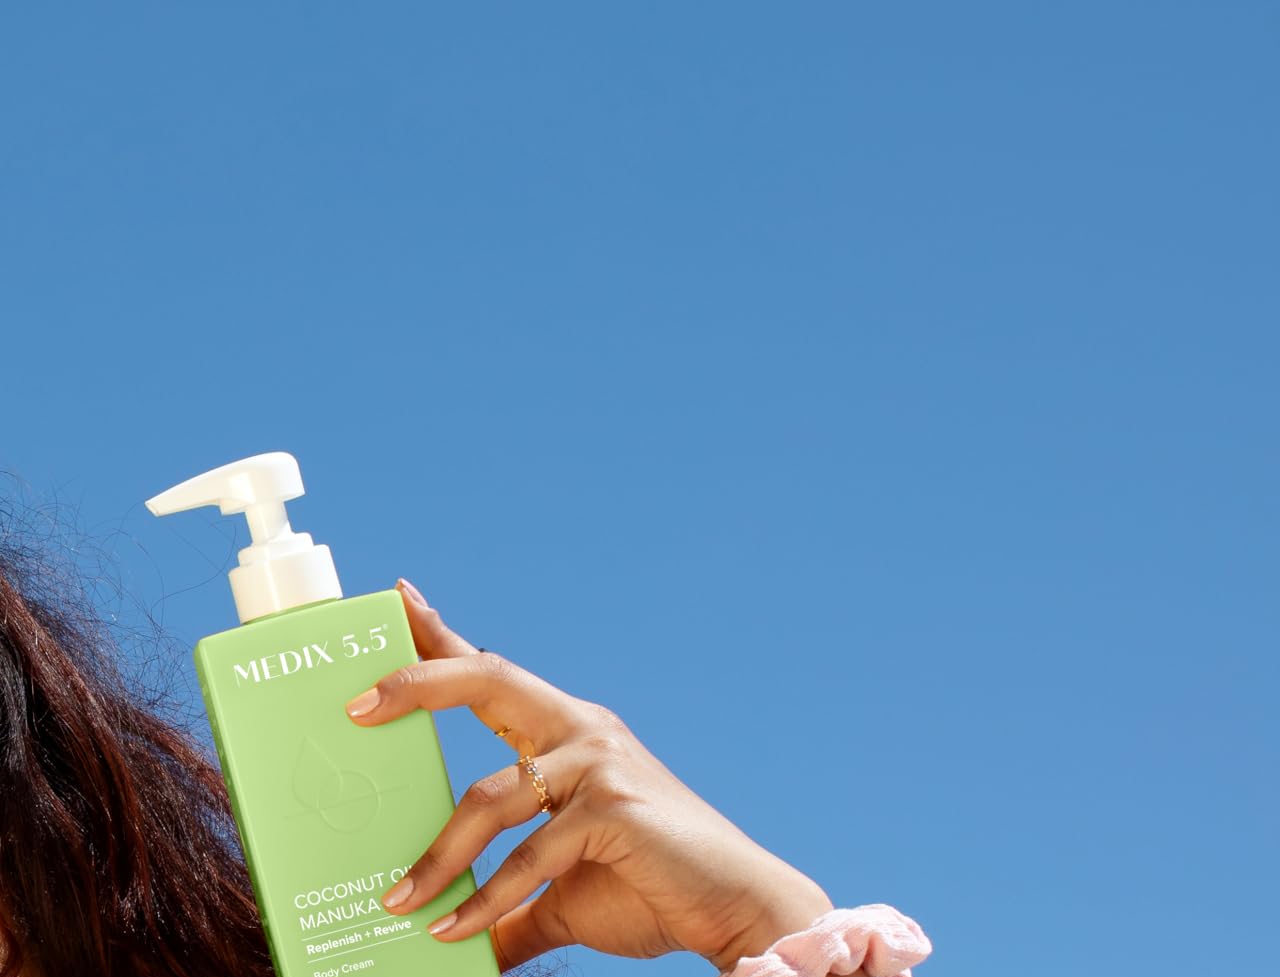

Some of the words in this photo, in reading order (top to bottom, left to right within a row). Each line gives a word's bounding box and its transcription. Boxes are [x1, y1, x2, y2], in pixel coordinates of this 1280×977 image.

[233, 641, 334, 688] MEDIX
[294, 872, 385, 909] COCONUT
[299, 898, 381, 931] MANUKA
[306, 932, 363, 955] Replenish
[364, 930, 372, 938] +
[373, 920, 412, 937] Revive
[341, 959, 375, 973] Cream
